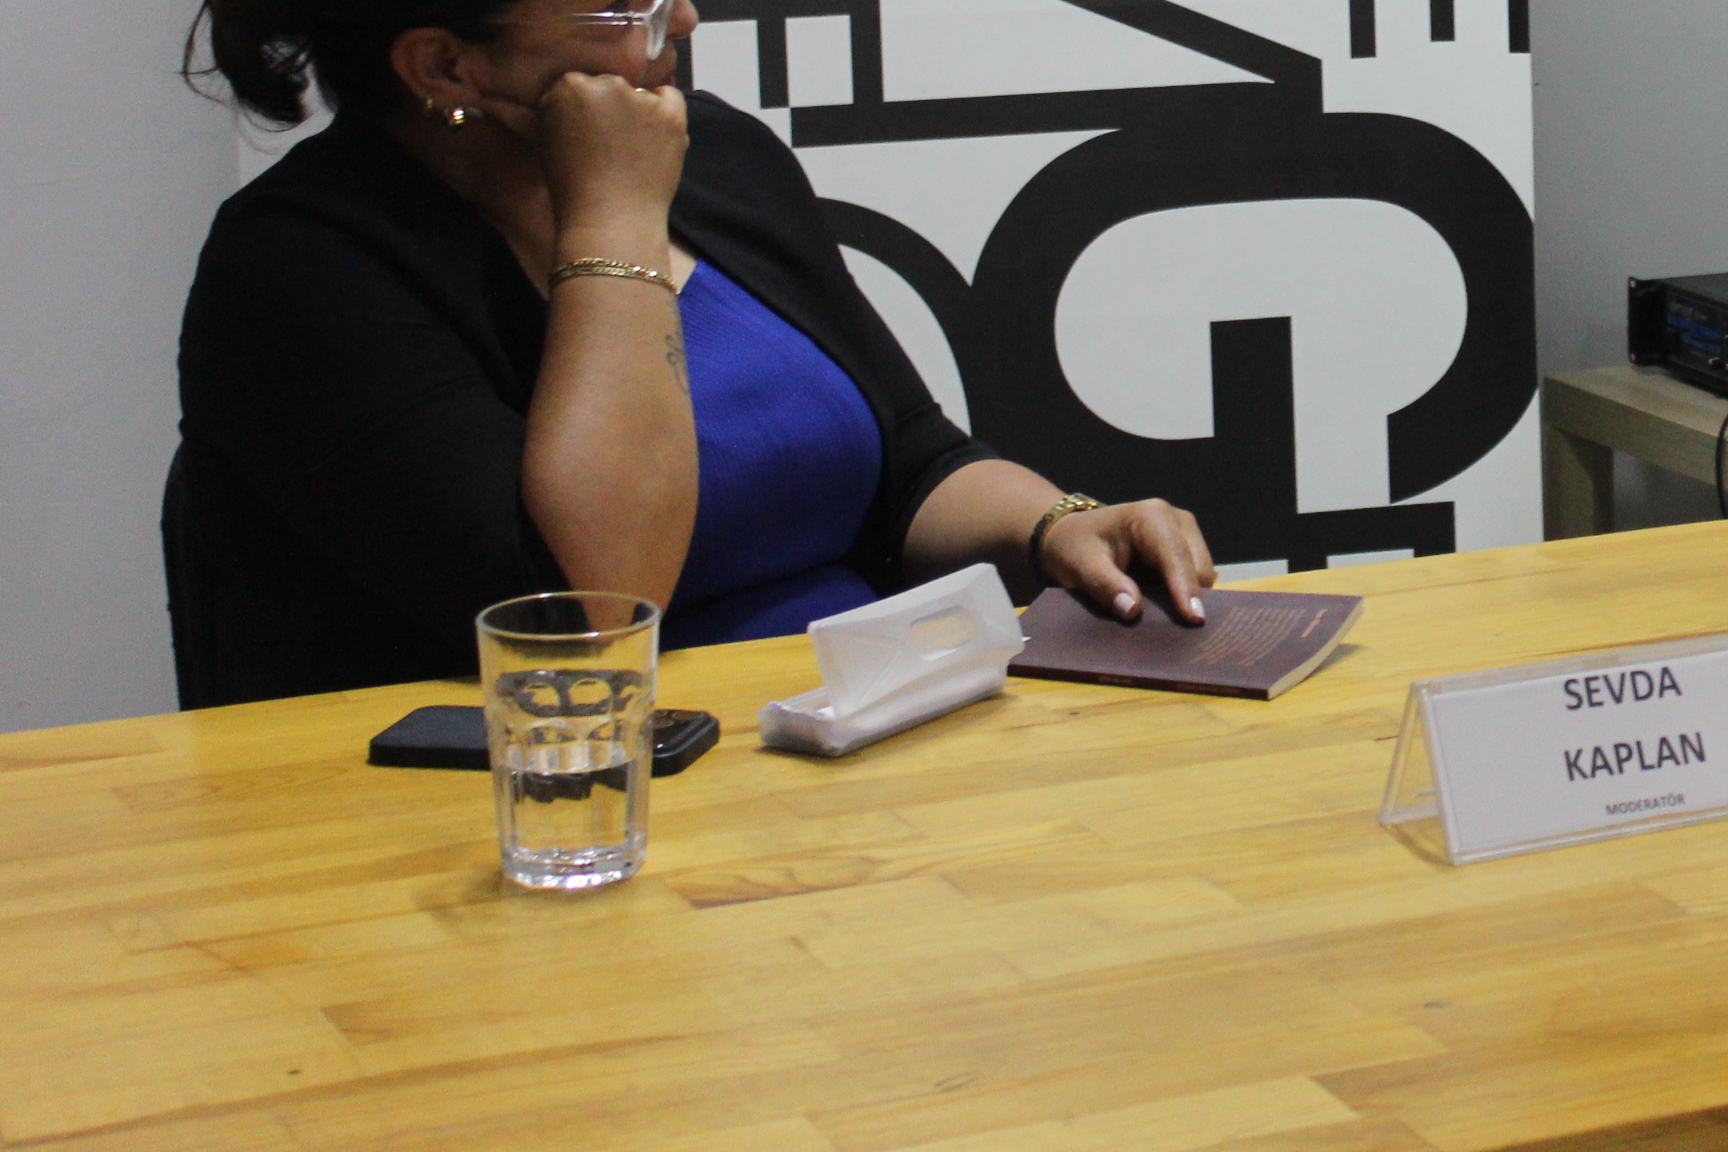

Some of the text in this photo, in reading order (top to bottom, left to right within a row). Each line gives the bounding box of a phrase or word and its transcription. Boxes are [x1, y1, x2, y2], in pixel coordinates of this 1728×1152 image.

[1563, 665, 1683, 711] SEVDA
[1564, 731, 1707, 782] KAPLAN
[1605, 793, 1686, 816] MODERATÖR
